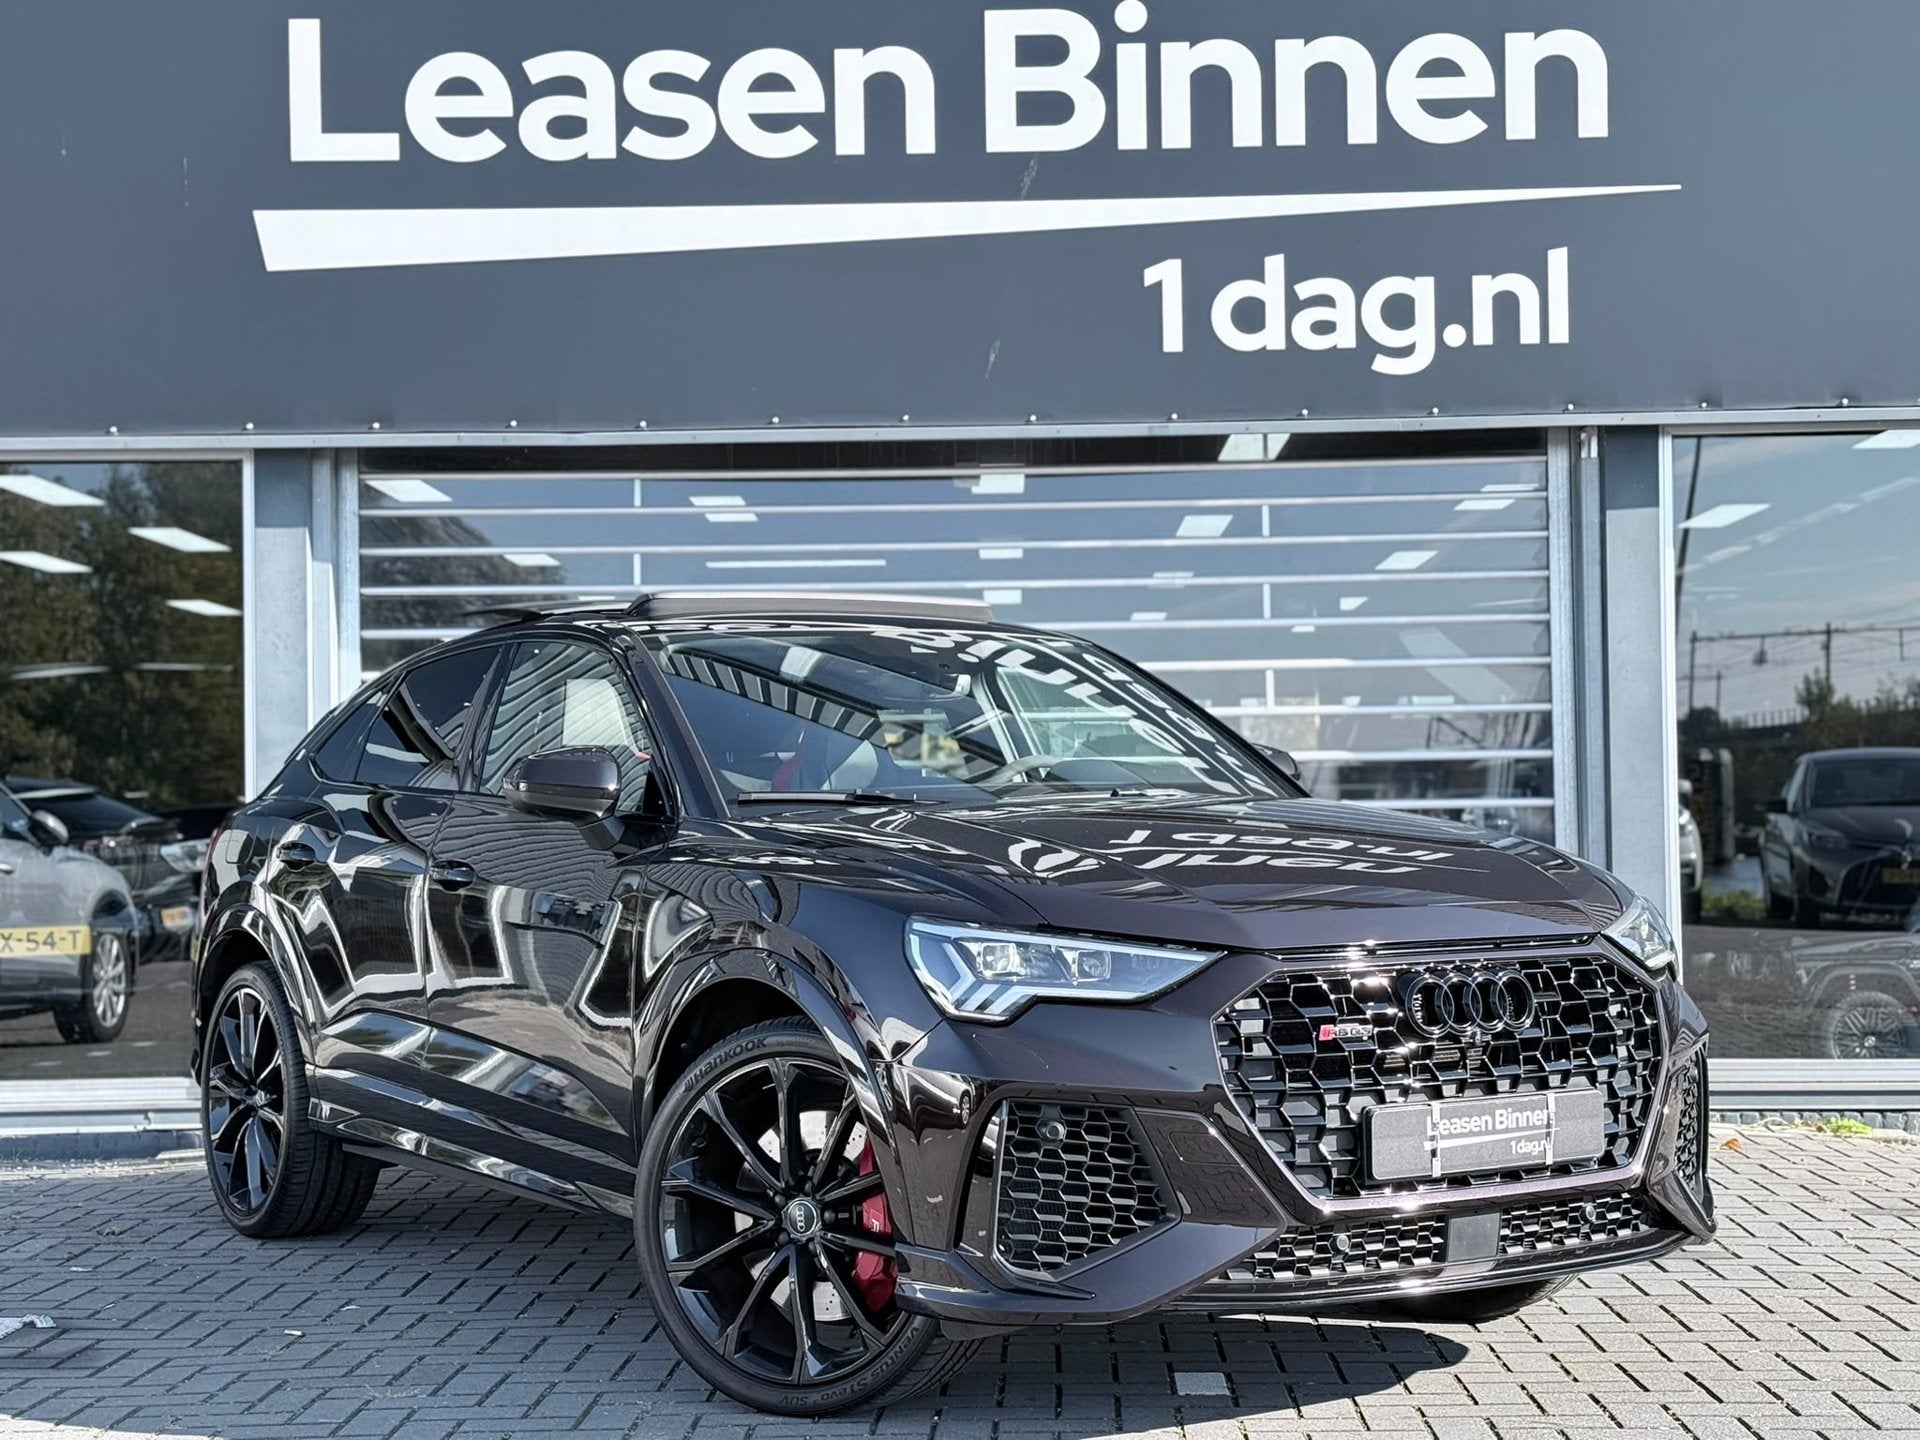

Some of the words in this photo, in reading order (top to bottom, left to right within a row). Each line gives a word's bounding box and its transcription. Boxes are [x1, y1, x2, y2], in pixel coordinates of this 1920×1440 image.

[287, 17, 937, 163] Leasen
[983, 0, 1610, 153] Binnen
[1143, 257, 1185, 353] 1
[1210, 246, 1570, 375] dag.nl
[1426, 1114, 1494, 1137] Leasen
